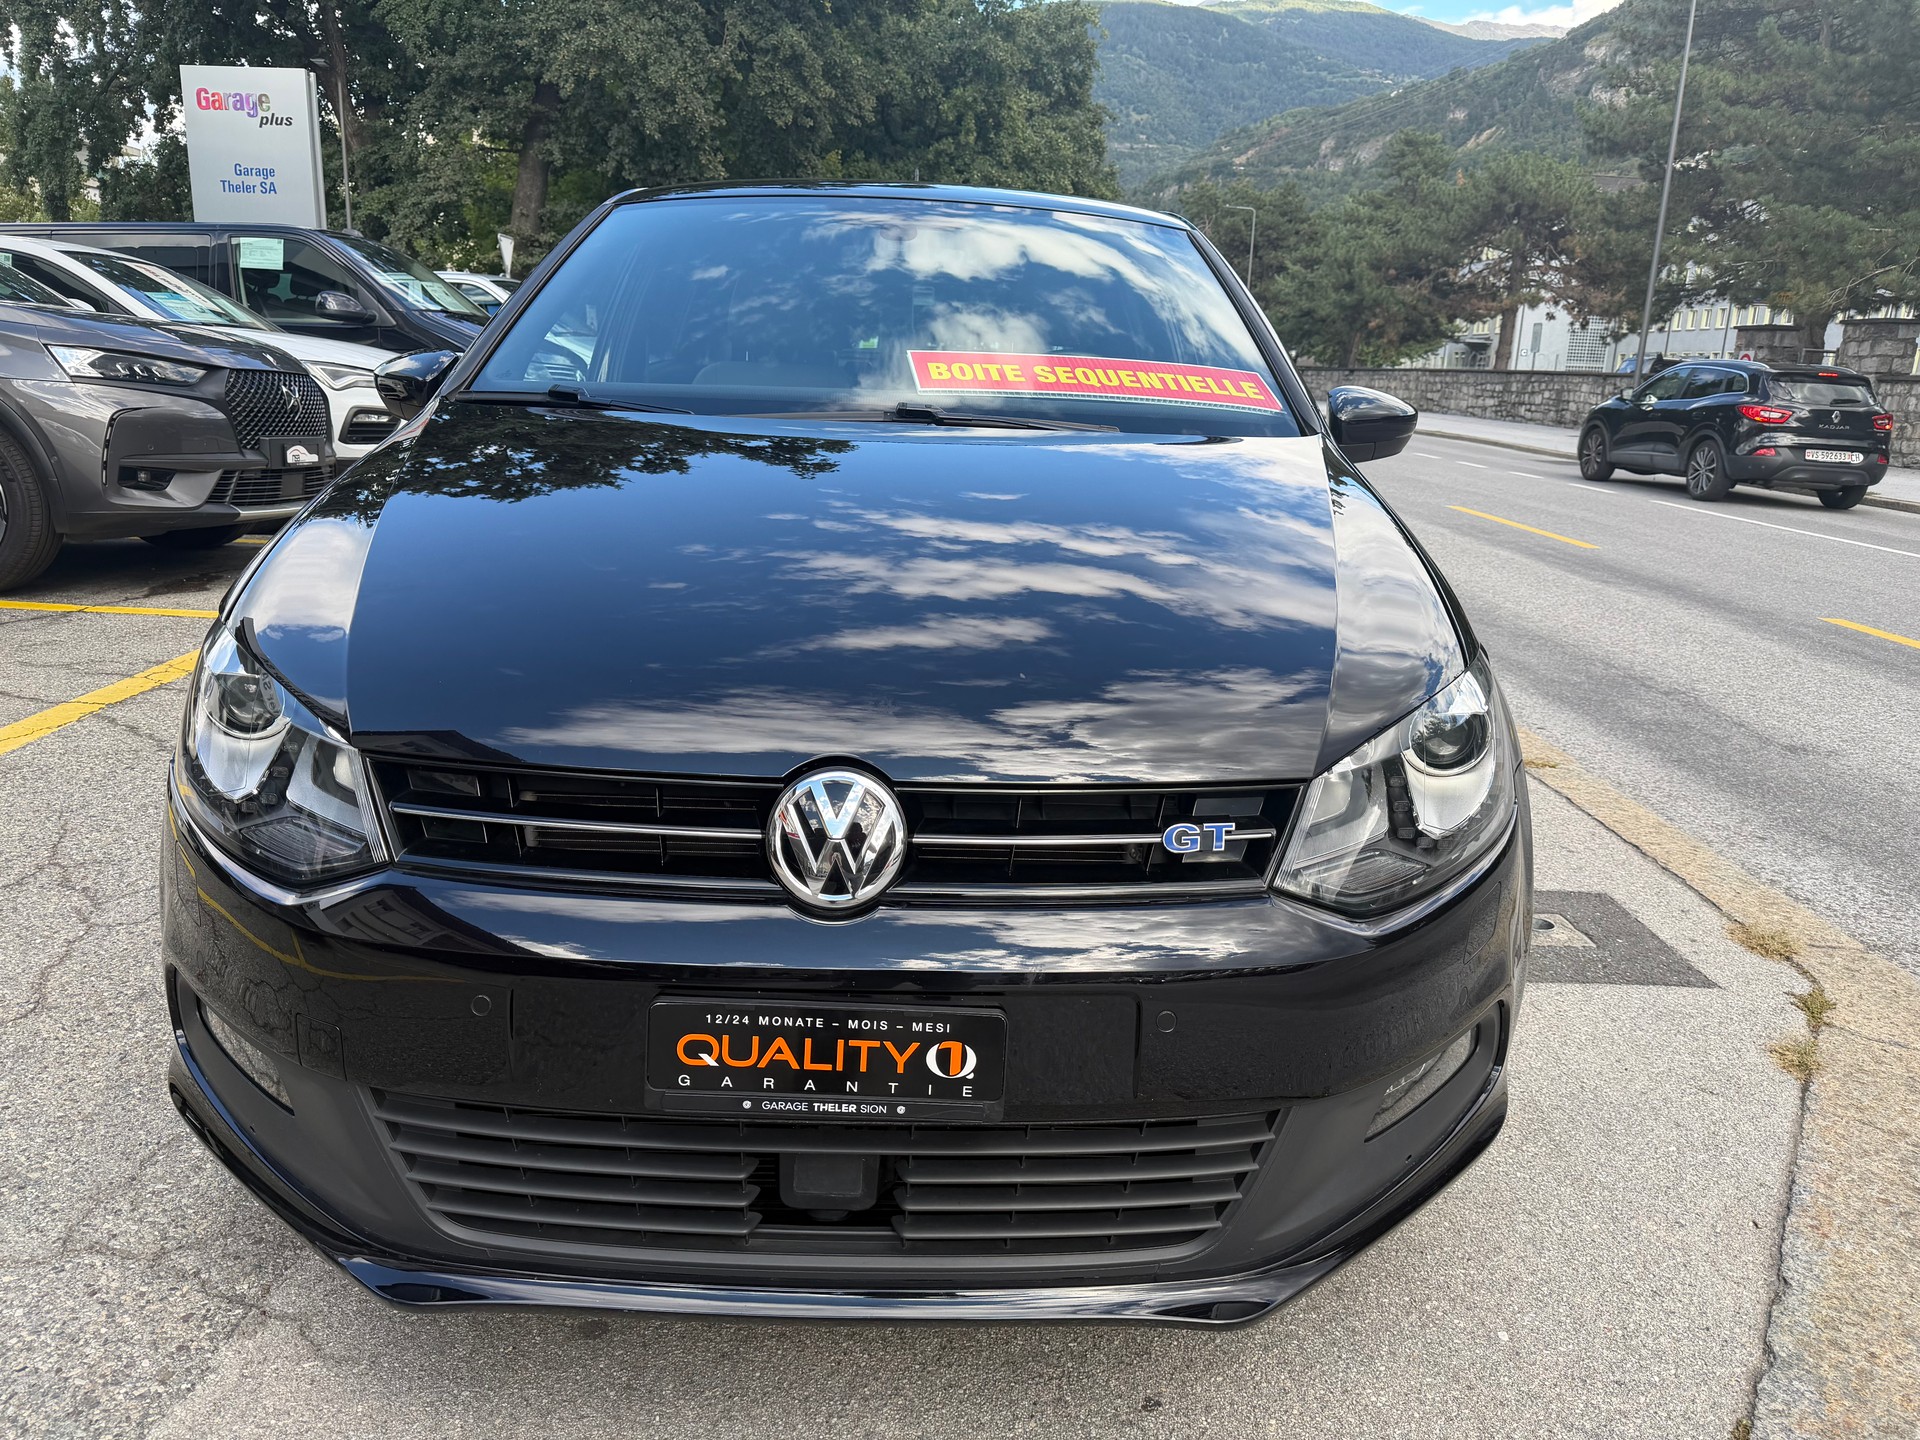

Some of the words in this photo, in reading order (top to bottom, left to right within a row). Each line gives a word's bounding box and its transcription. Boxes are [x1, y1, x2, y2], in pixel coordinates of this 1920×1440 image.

[195, 87, 271, 118] Garage
[258, 112, 293, 128] plus
[234, 163, 276, 180] Garage
[220, 180, 257, 194] Theler
[260, 181, 277, 194] SA
[927, 361, 1026, 383] BOITE
[1035, 365, 1265, 400] SEQUENTIELLE
[1821, 452, 1847, 461] 592633
[1162, 822, 1236, 854] GT
[705, 1013, 750, 1025] 12/24
[758, 1015, 825, 1028] MONATE
[847, 1019, 889, 1031] MOIS
[911, 1021, 950, 1033] MESI
[676, 1033, 920, 1074] QUALITY
[677, 1074, 973, 1098] GARANTIE
[761, 1100, 809, 1112] GARAGE
[812, 1102, 857, 1114] THELER
[859, 1104, 888, 1115] SION
